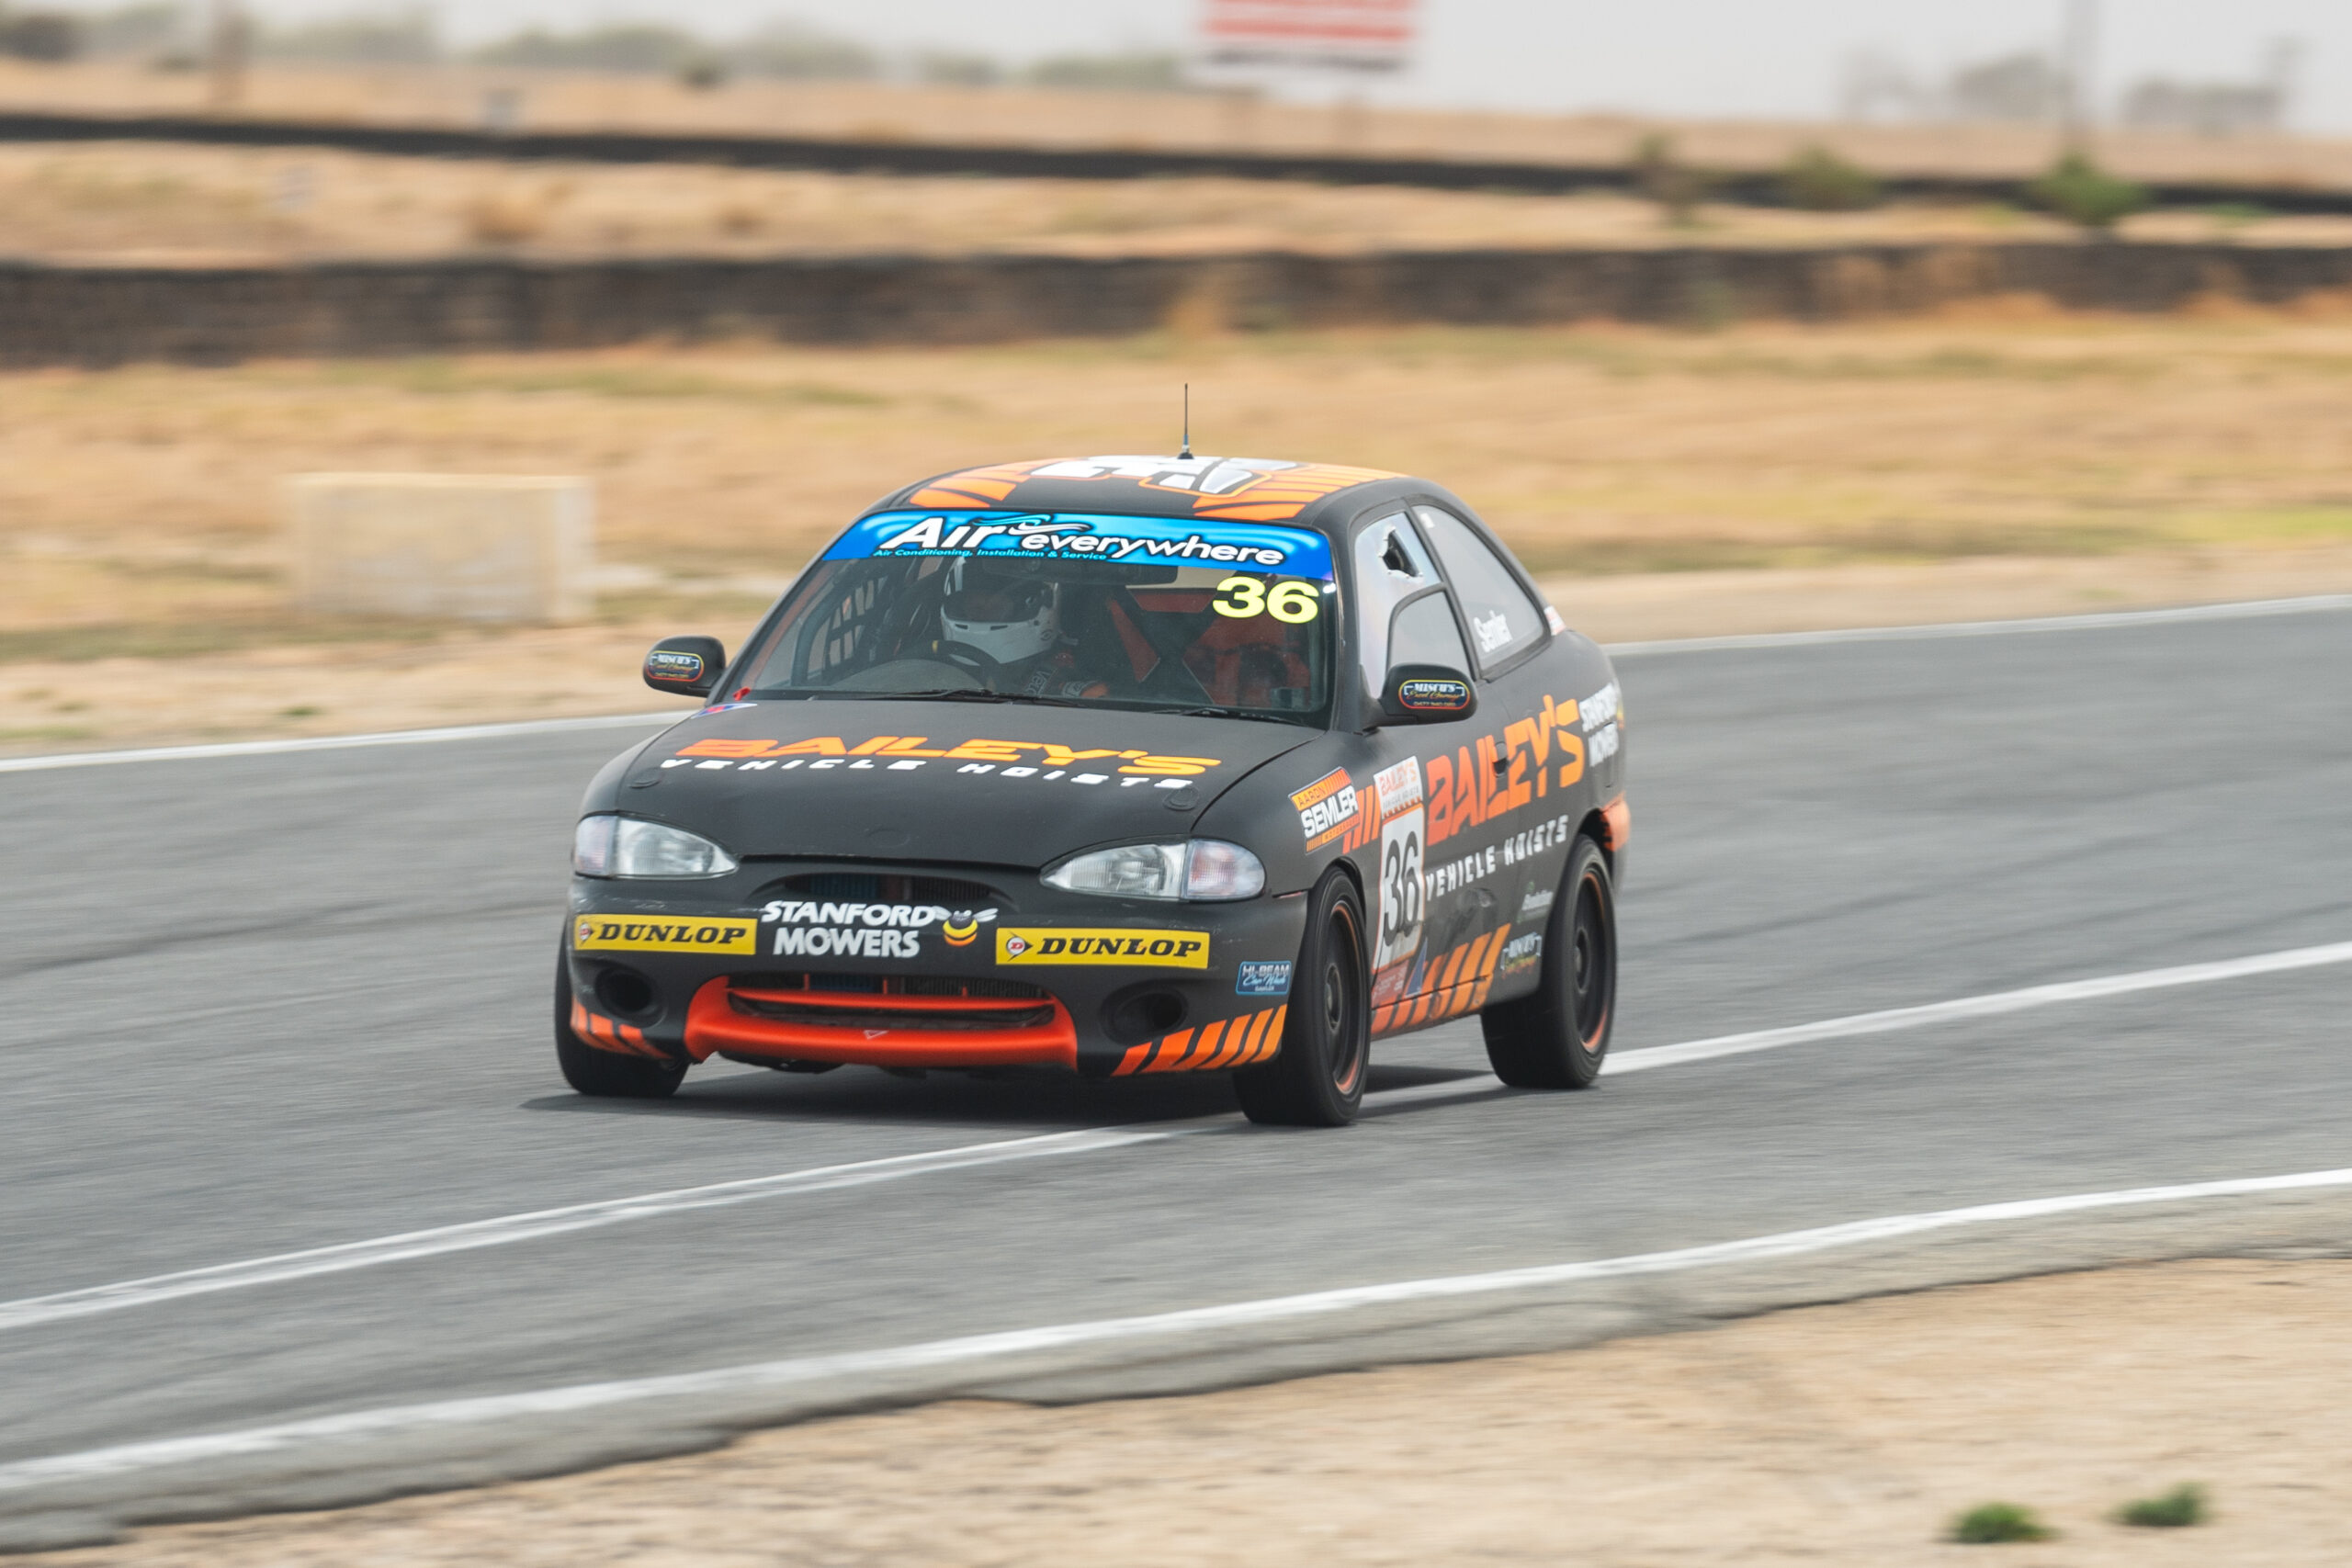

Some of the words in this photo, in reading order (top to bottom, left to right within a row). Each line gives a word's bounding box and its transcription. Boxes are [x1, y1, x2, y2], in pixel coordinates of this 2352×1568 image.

[879, 516, 1007, 549] Air
[1021, 533, 1284, 566] everywhere
[978, 549, 1045, 558] Installation
[1061, 551, 1107, 560] Service
[1212, 576, 1319, 624] 36
[675, 736, 1222, 776] BAILEY'S
[1426, 694, 1585, 847] BAILEY'S
[660, 759, 928, 771] VEHICLE
[956, 763, 1193, 790] HOISTS
[1300, 784, 1359, 839] SEMLER
[1425, 844, 1496, 902] VEHICLE
[1503, 814, 1569, 866] HOISTS
[1383, 830, 1419, 947] 36
[762, 900, 935, 927] STANFORD
[596, 923, 747, 944] DUNLOP
[773, 926, 921, 958] MOWERS
[1036, 937, 1202, 958] DUNLOP
[1242, 964, 1290, 977] HI-BEAM
